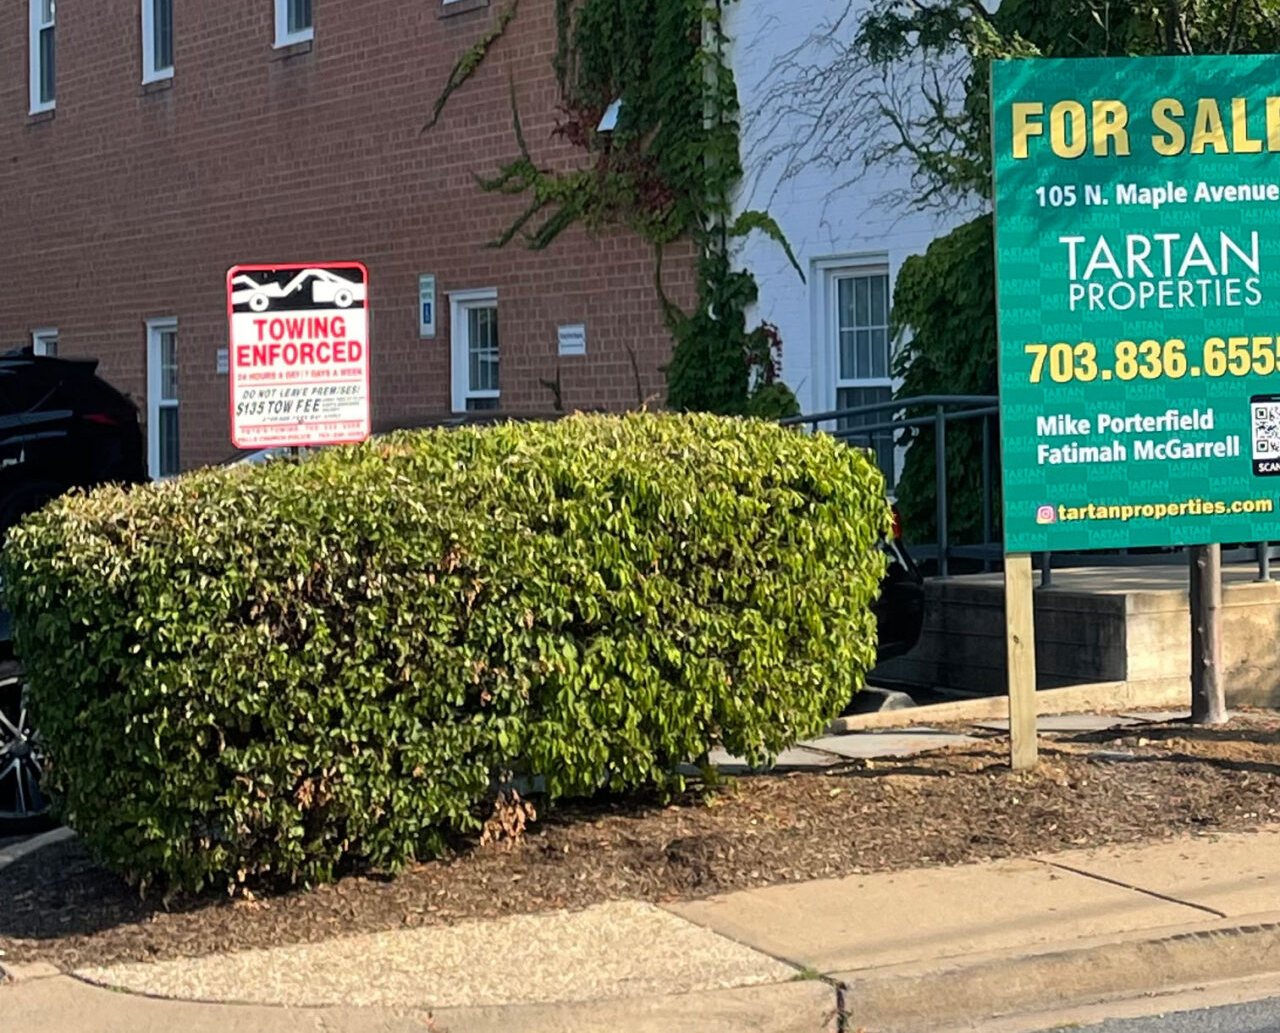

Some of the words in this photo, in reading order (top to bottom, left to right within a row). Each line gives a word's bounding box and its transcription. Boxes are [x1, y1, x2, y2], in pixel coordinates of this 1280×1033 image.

[1011, 99, 1130, 159] FOR
[1035, 185, 1077, 207] 105
[1084, 184, 1108, 206] N.
[1116, 181, 1187, 209] Maple
[1194, 181, 1280, 203] Avenue
[1059, 230, 1260, 281] TARTAN
[1069, 277, 1262, 311] PROPERTIES
[253, 315, 346, 342] TOWING
[237, 340, 362, 367] ENFORCED
[242, 390, 256, 399] DO
[258, 388, 277, 398] NOT
[279, 387, 308, 398] LEAVE
[236, 400, 264, 417] $135
[268, 399, 293, 414] TOW
[295, 398, 322, 413] FEE
[1036, 414, 1091, 437] Mike
[1097, 409, 1214, 434] Porterfield
[1037, 441, 1126, 465] Fatimah
[1134, 435, 1240, 461] McGarrell
[1058, 498, 1273, 522] tartanproperties.com
